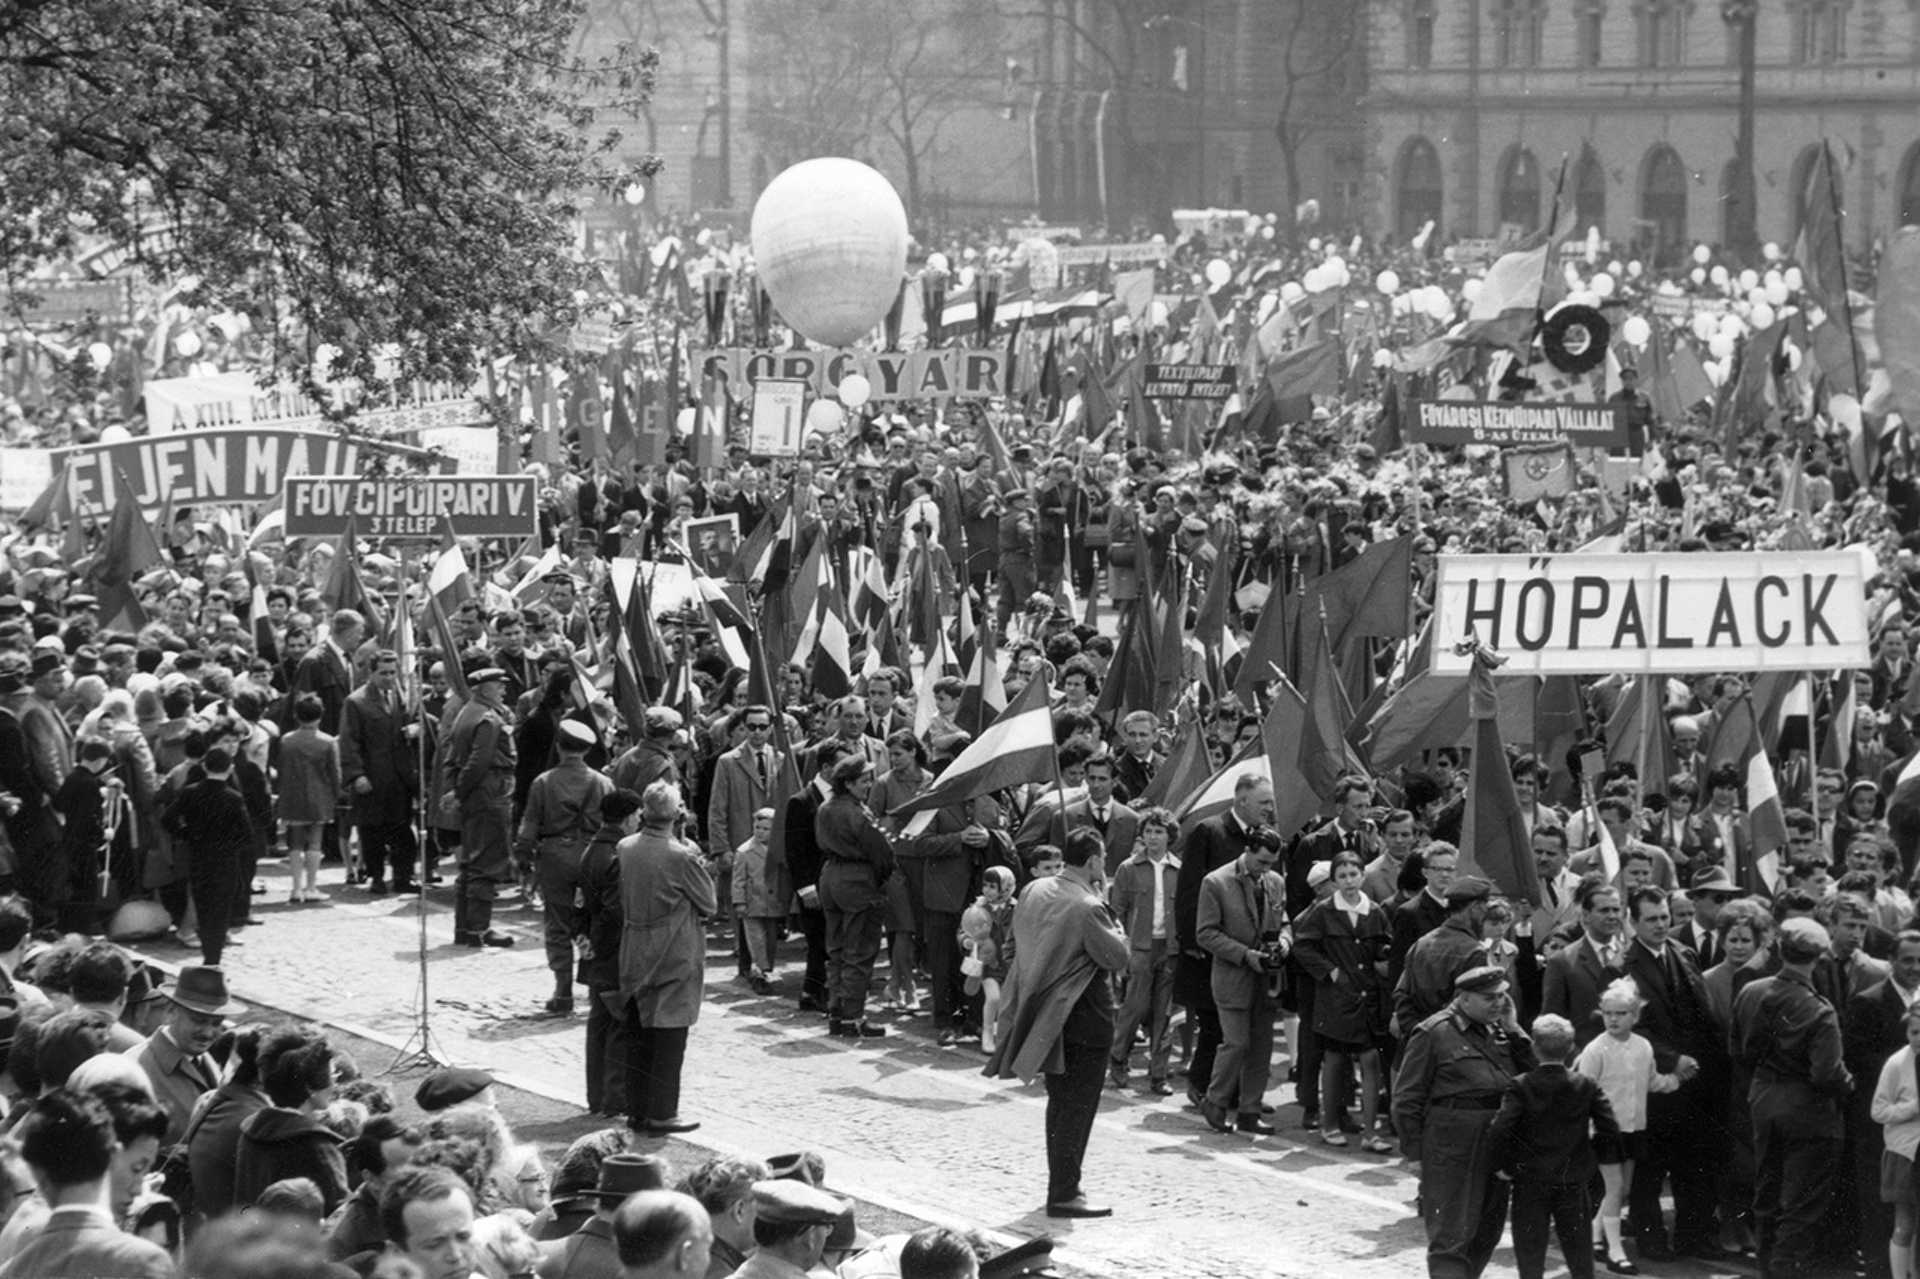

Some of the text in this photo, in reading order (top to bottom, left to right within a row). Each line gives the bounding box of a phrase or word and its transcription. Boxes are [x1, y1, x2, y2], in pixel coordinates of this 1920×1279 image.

[1420, 403, 1482, 428] FŐVÁROSI
[506, 481, 528, 517] V.
[370, 516, 437, 534] 3 TELEP
[1464, 556, 1841, 652] HŐPALACK
